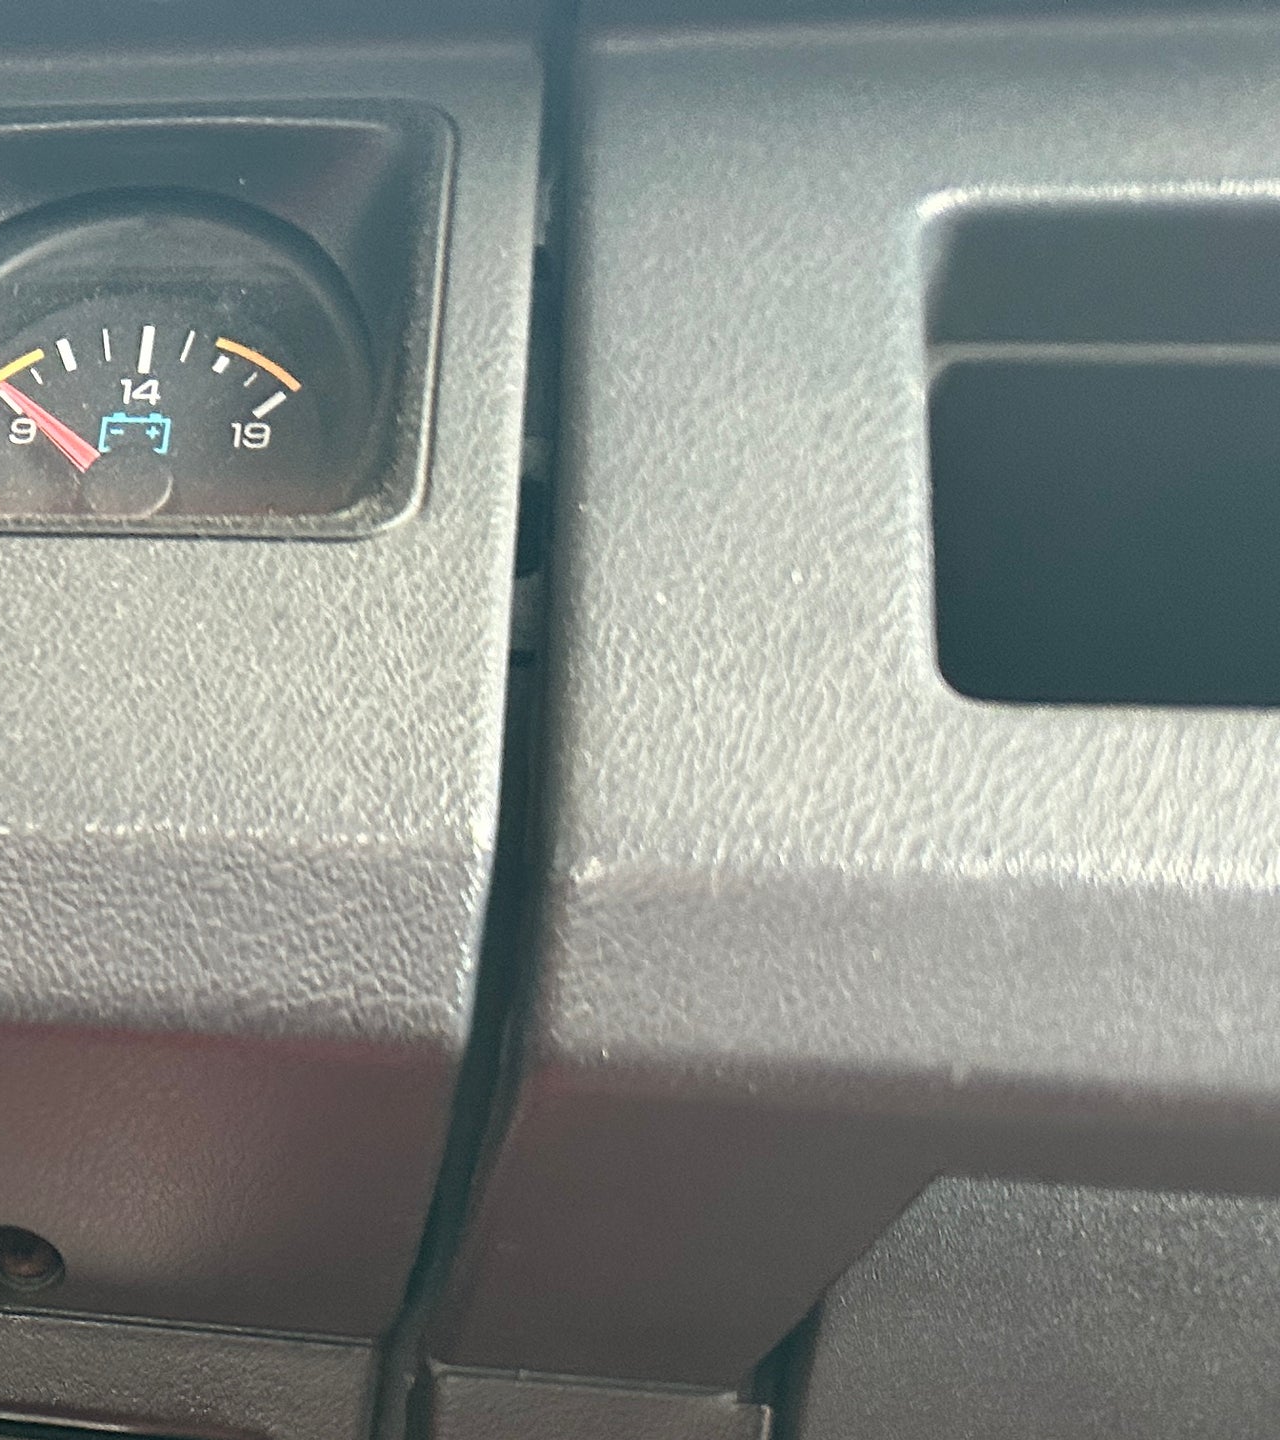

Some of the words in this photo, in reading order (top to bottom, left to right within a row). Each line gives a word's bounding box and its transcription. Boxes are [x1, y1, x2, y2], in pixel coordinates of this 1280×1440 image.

[120, 379, 161, 405] 14
[8, 417, 37, 445] 9
[231, 421, 271, 449] 19
